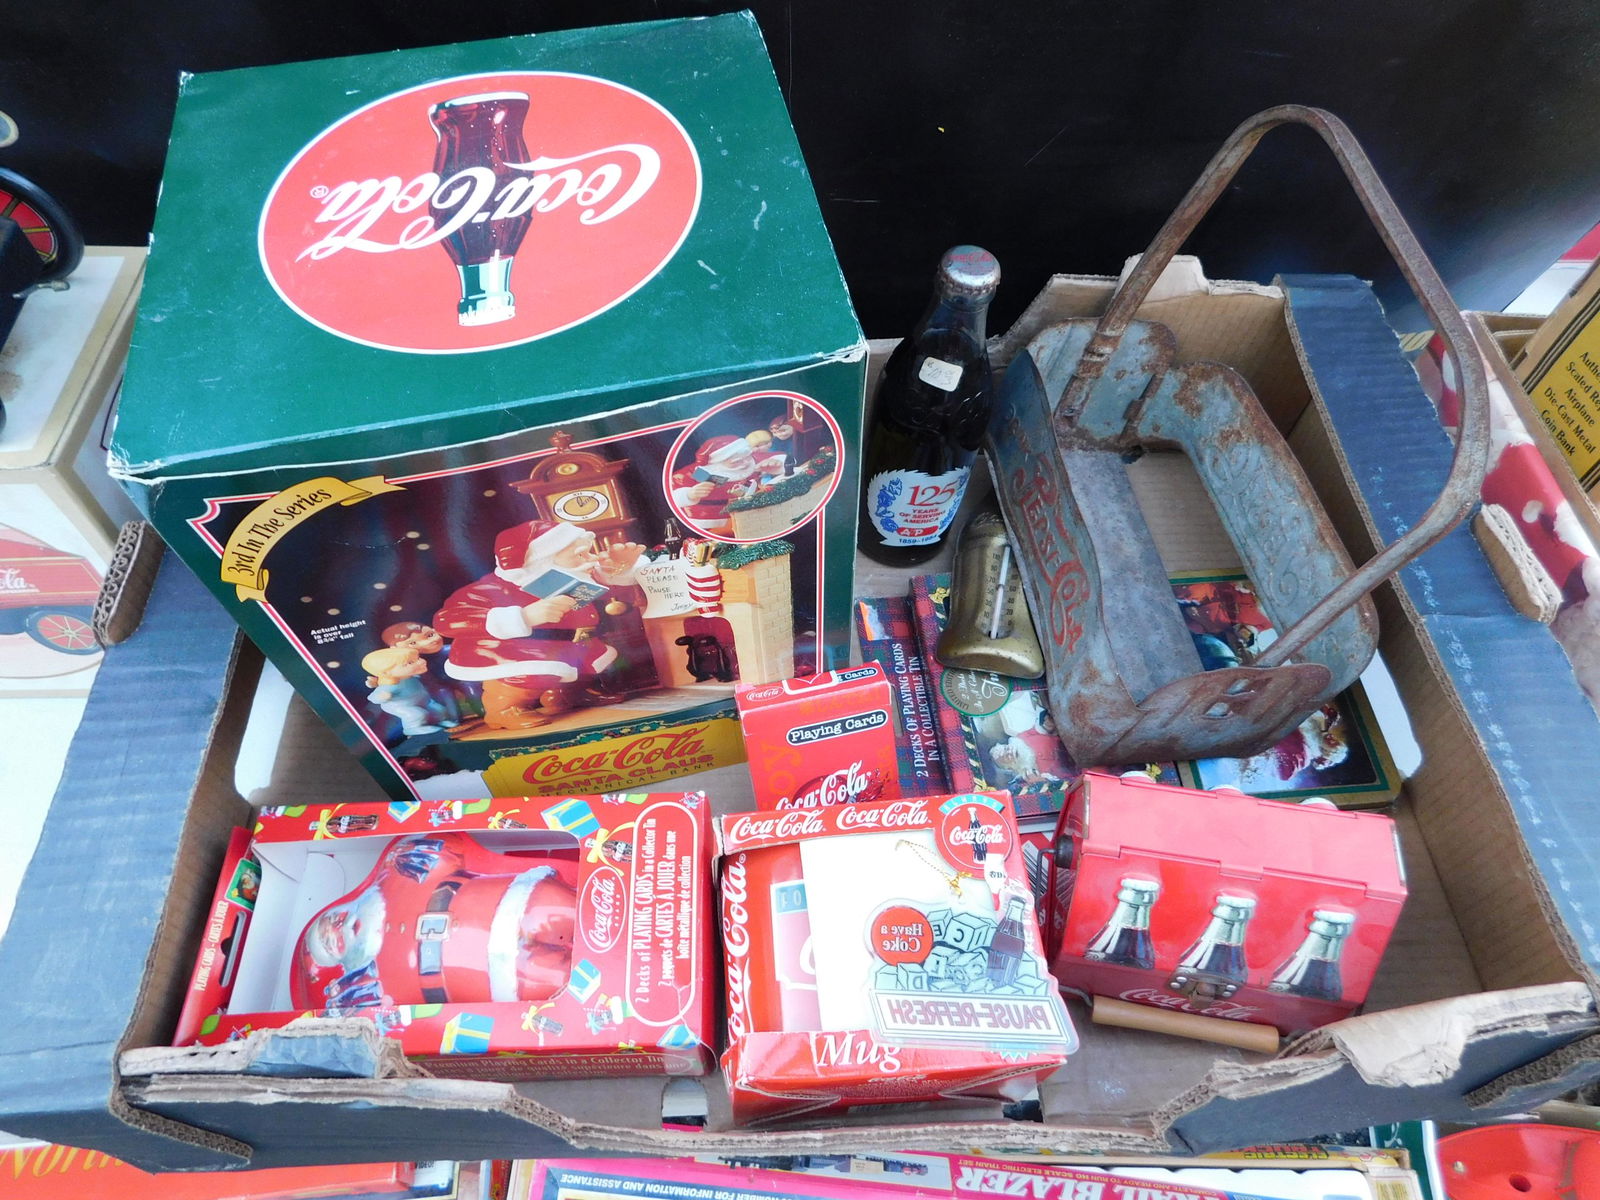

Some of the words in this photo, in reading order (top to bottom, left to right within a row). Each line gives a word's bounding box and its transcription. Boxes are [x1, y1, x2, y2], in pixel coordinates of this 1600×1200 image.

[1566, 361, 1593, 394] Scaled
[1565, 388, 1595, 428] Airplane
[1544, 386, 1575, 428] Die-Cast
[1573, 424, 1597, 454] Metal
[1541, 409, 1557, 433] Coin
[1556, 429, 1576, 457] Bank
[908, 480, 959, 506] 125
[273, 488, 332, 520] Series
[248, 518, 285, 540] The
[237, 539, 265, 554] In
[228, 552, 257, 577] 3rd
[640, 566, 676, 576] SANTA
[646, 575, 678, 583] PLEASE
[648, 586, 672, 594] PAUSE
[311, 625, 338, 636] Actual
[339, 619, 367, 629] height
[323, 630, 342, 638] over
[340, 632, 354, 640] tall
[892, 643, 907, 674] CARDS
[908, 656, 920, 673] TIN
[845, 668, 875, 679] Cards
[899, 676, 916, 714] PLAYING
[912, 674, 935, 737] COLLECTIBLE
[791, 723, 843, 742] Playing
[845, 712, 884, 731] Cards
[906, 717, 919, 731] OF
[910, 733, 927, 768] DECKS
[925, 739, 936, 747] A
[523, 725, 710, 785] Coca-Cola
[928, 750, 940, 761] IN
[538, 773, 624, 793] SANTA
[628, 754, 714, 778] CLAUS
[670, 762, 715, 776] BANK
[916, 770, 929, 778] 2
[643, 818, 656, 829] Tin
[730, 809, 823, 844] Coca-Cola
[836, 800, 928, 830] Coca-Cola
[641, 829, 656, 858] Collector
[666, 830, 676, 843] une
[949, 824, 1004, 846] Coca-Cola
[662, 844, 676, 860] dans
[642, 864, 655, 872] in
[656, 860, 675, 891] JOUER
[677, 855, 691, 889] collection
[634, 873, 654, 904] CARDS
[676, 890, 691, 899] de
[589, 876, 615, 948] Coca-Cola
[654, 901, 675, 938] CARTES
[676, 899, 692, 938] métallique
[632, 907, 653, 950] PLAYING
[659, 938, 673, 948] de
[637, 952, 651, 962] of
[661, 949, 675, 979] paquets
[193, 966, 211, 991] PLAYING
[202, 947, 216, 966] CARDS
[635, 965, 651, 993] Decks
[480, 1058, 527, 1068] Playing
[528, 1057, 561, 1066] Cards
[565, 1057, 578, 1065] in
[590, 1056, 643, 1065] Collector
[647, 1055, 665, 1063] Tin
[815, 1033, 900, 1073] Mug
[957, 1158, 973, 1168] SET
[975, 1161, 999, 1171] TRAIN
[1001, 1164, 1042, 1176] ELECTRIC
[560, 1173, 622, 1189] ASSISTANCE
[1043, 1169, 1073, 1179] SCALE
[1075, 1172, 1089, 1181] HO
[1091, 1173, 1109, 1183] RUN
[1110, 1176, 1121, 1184] TO
[623, 1180, 644, 1192] AND
[645, 1182, 713, 1199] INFORMATION
[955, 1166, 1105, 1200] BLAZER
[1122, 1178, 1152, 1188] READY
[1153, 1182, 1171, 1190] AND
[714, 1189, 736, 1200] FOR
